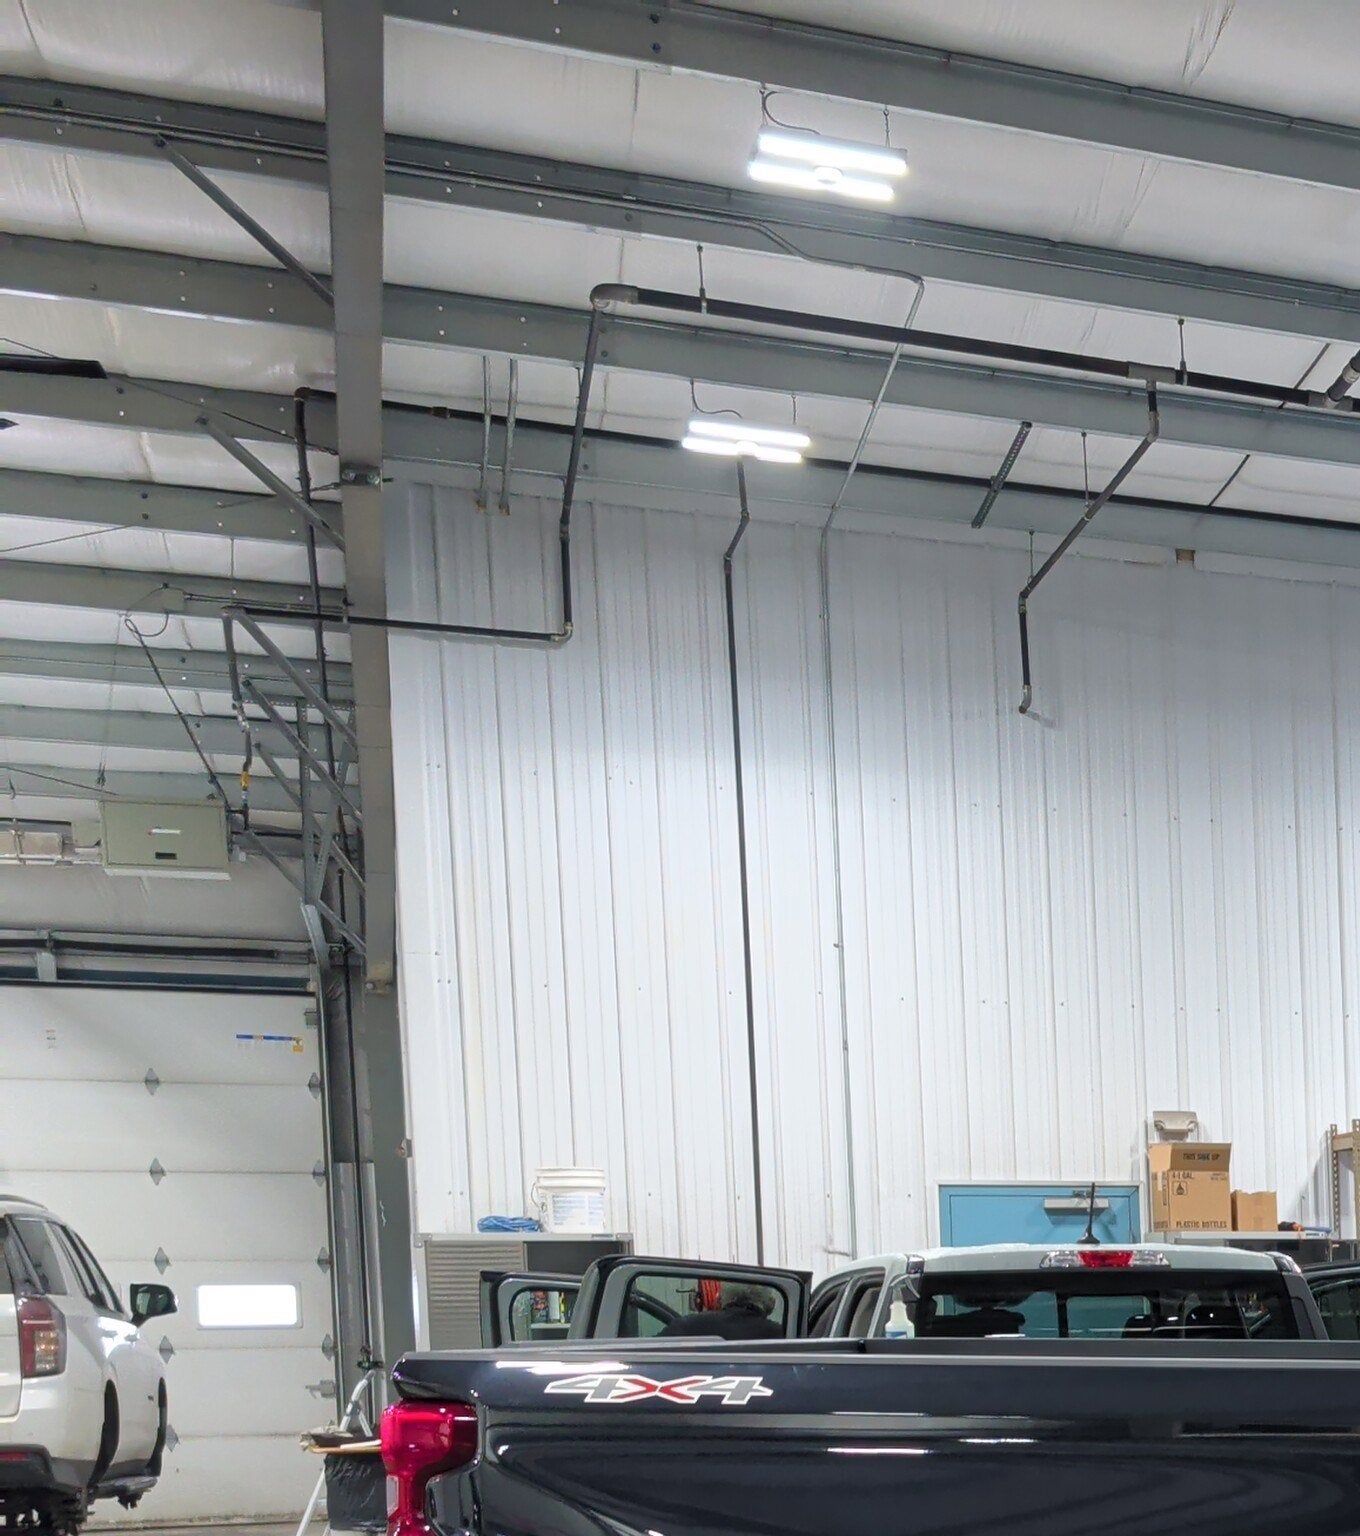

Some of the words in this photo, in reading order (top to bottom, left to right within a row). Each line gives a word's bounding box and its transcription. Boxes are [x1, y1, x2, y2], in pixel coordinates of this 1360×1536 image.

[1211, 1152, 1221, 1161] UP
[1176, 1220, 1200, 1229] PLASTIC
[1202, 1220, 1227, 1229] BOTTLES
